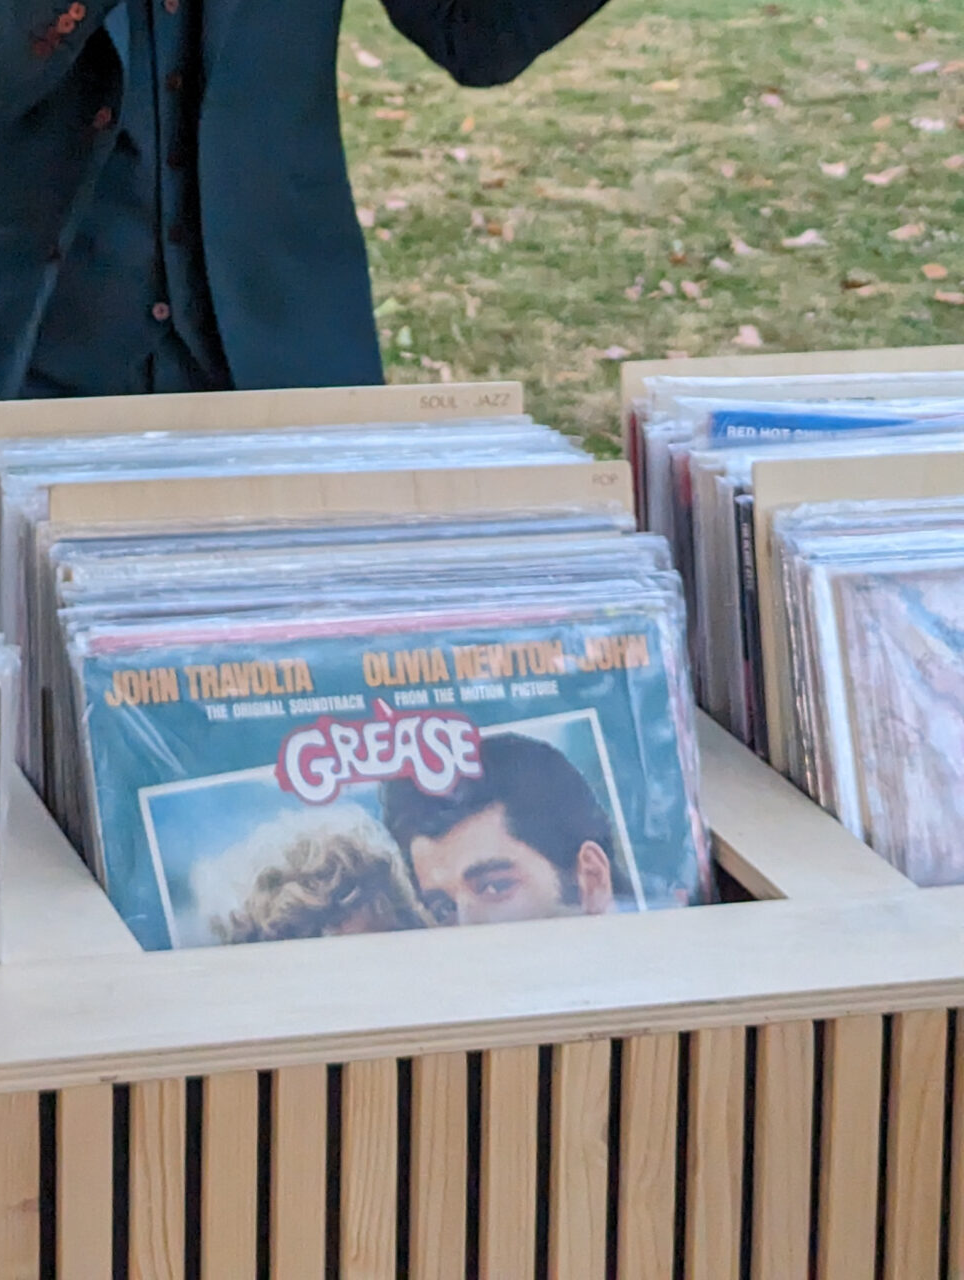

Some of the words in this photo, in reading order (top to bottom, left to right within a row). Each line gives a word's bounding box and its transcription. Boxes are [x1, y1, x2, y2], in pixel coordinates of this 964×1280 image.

[420, 394, 458, 410] SOUL
[472, 392, 511, 408] JAZZ
[726, 425, 756, 439] RED
[759, 426, 791, 440] HOT
[592, 473, 619, 486] POP
[362, 646, 450, 687] OLIVIA
[104, 667, 180, 707] JOHN
[183, 658, 314, 700] TRAVOLTA
[393, 688, 429, 707] FROM
[432, 686, 456, 704] THE
[459, 682, 505, 703] MOTION
[510, 679, 559, 698] PICTURE
[205, 703, 229, 720] THE
[232, 700, 286, 719] ORIGINAL
[288, 694, 366, 715] SOUNDTRACK
[284, 716, 482, 802] GREASE
